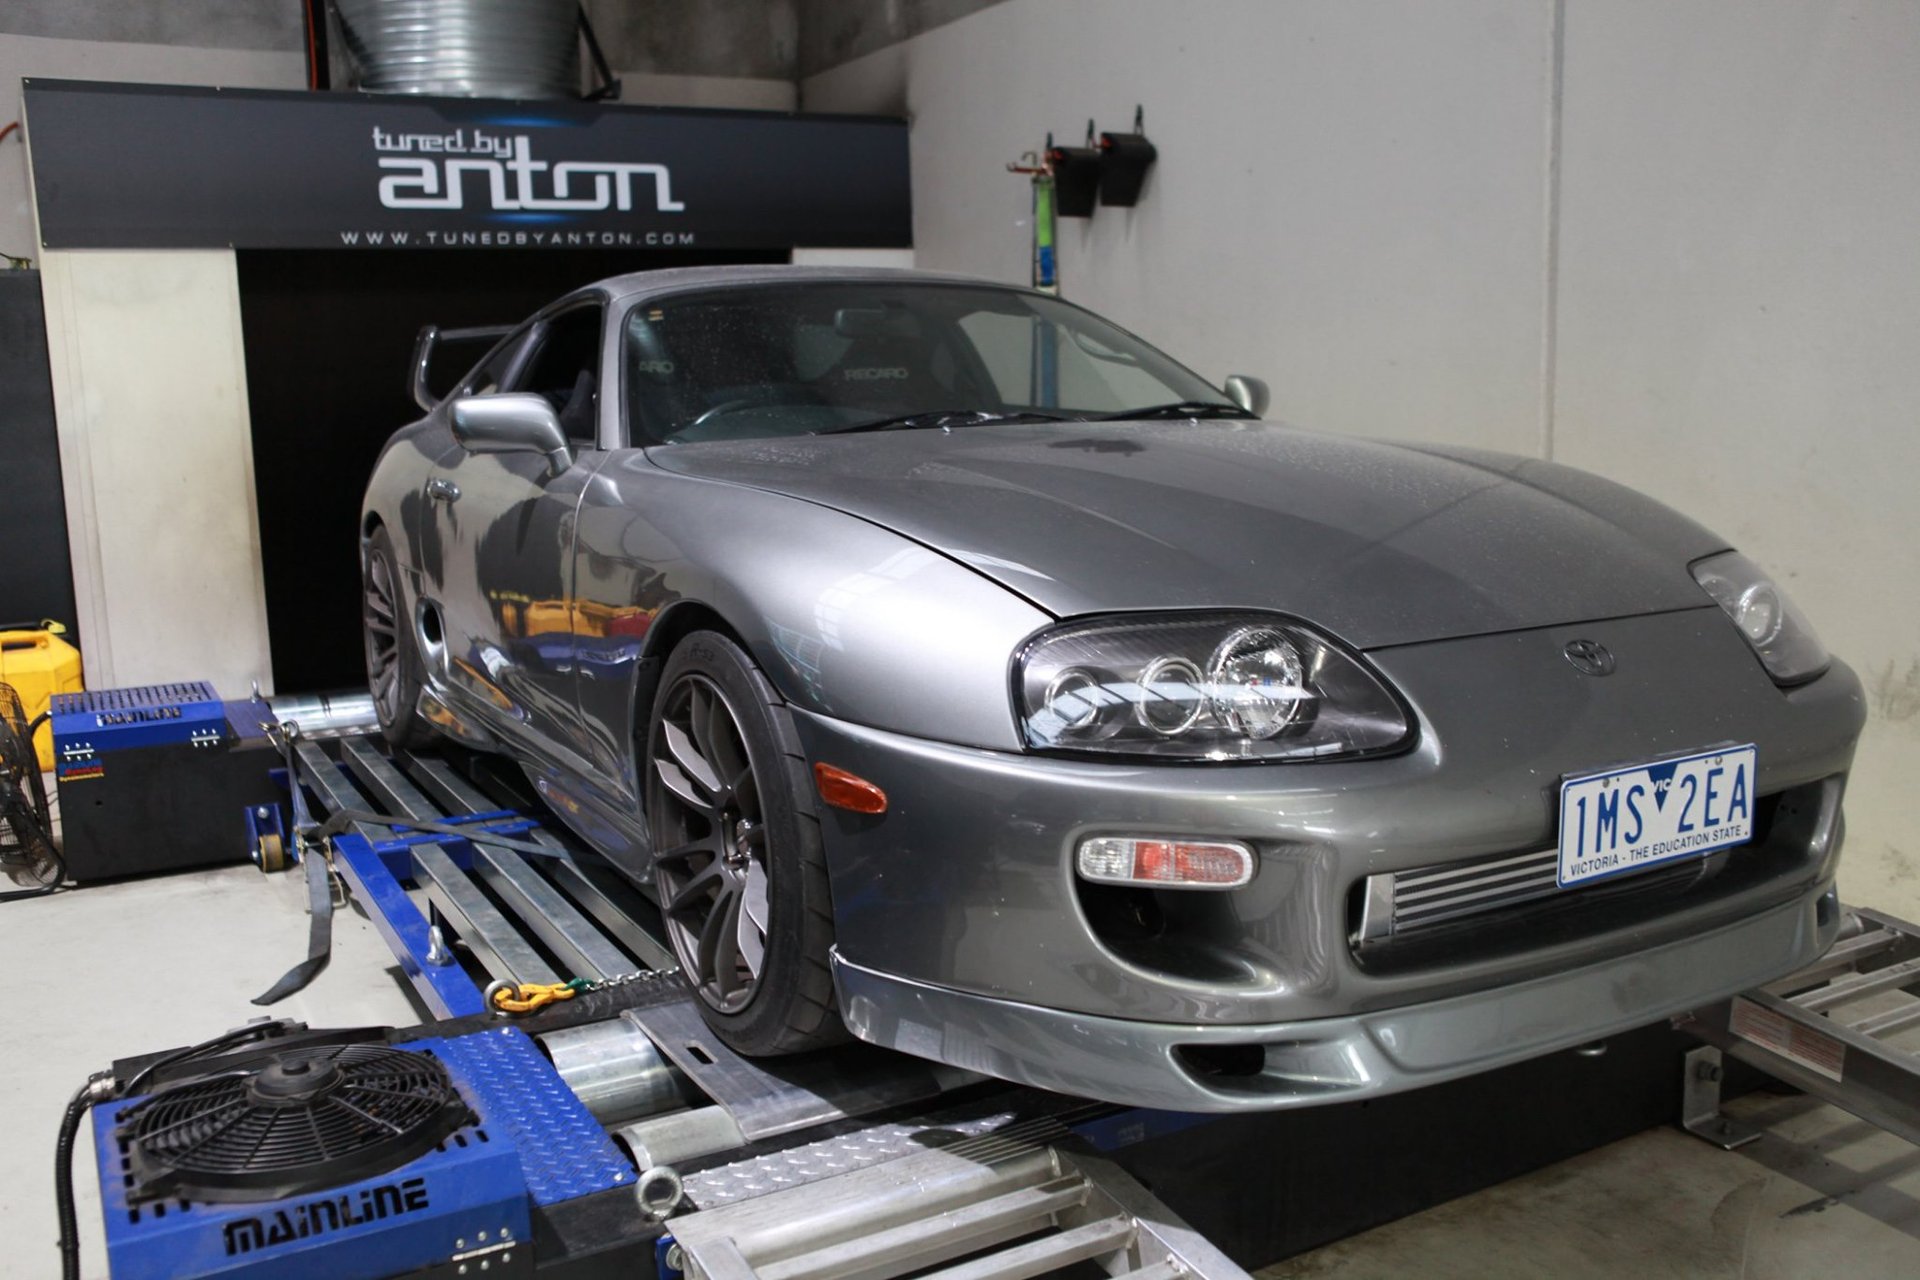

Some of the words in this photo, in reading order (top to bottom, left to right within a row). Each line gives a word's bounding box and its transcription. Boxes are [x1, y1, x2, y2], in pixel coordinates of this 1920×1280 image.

[372, 126, 467, 152] tuned
[470, 129, 512, 158] by
[378, 135, 685, 211] anton
[341, 231, 695, 246] WWW.TUNEDBYANTON.COM
[844, 367, 909, 380] RECARO
[1576, 785, 1645, 858] 1MS
[1677, 763, 1748, 834] 2EA
[1570, 854, 1619, 876] VICTORIA
[1630, 846, 1649, 860] THE
[1652, 833, 1710, 856] EDUCATION
[1712, 824, 1741, 842] STATE
